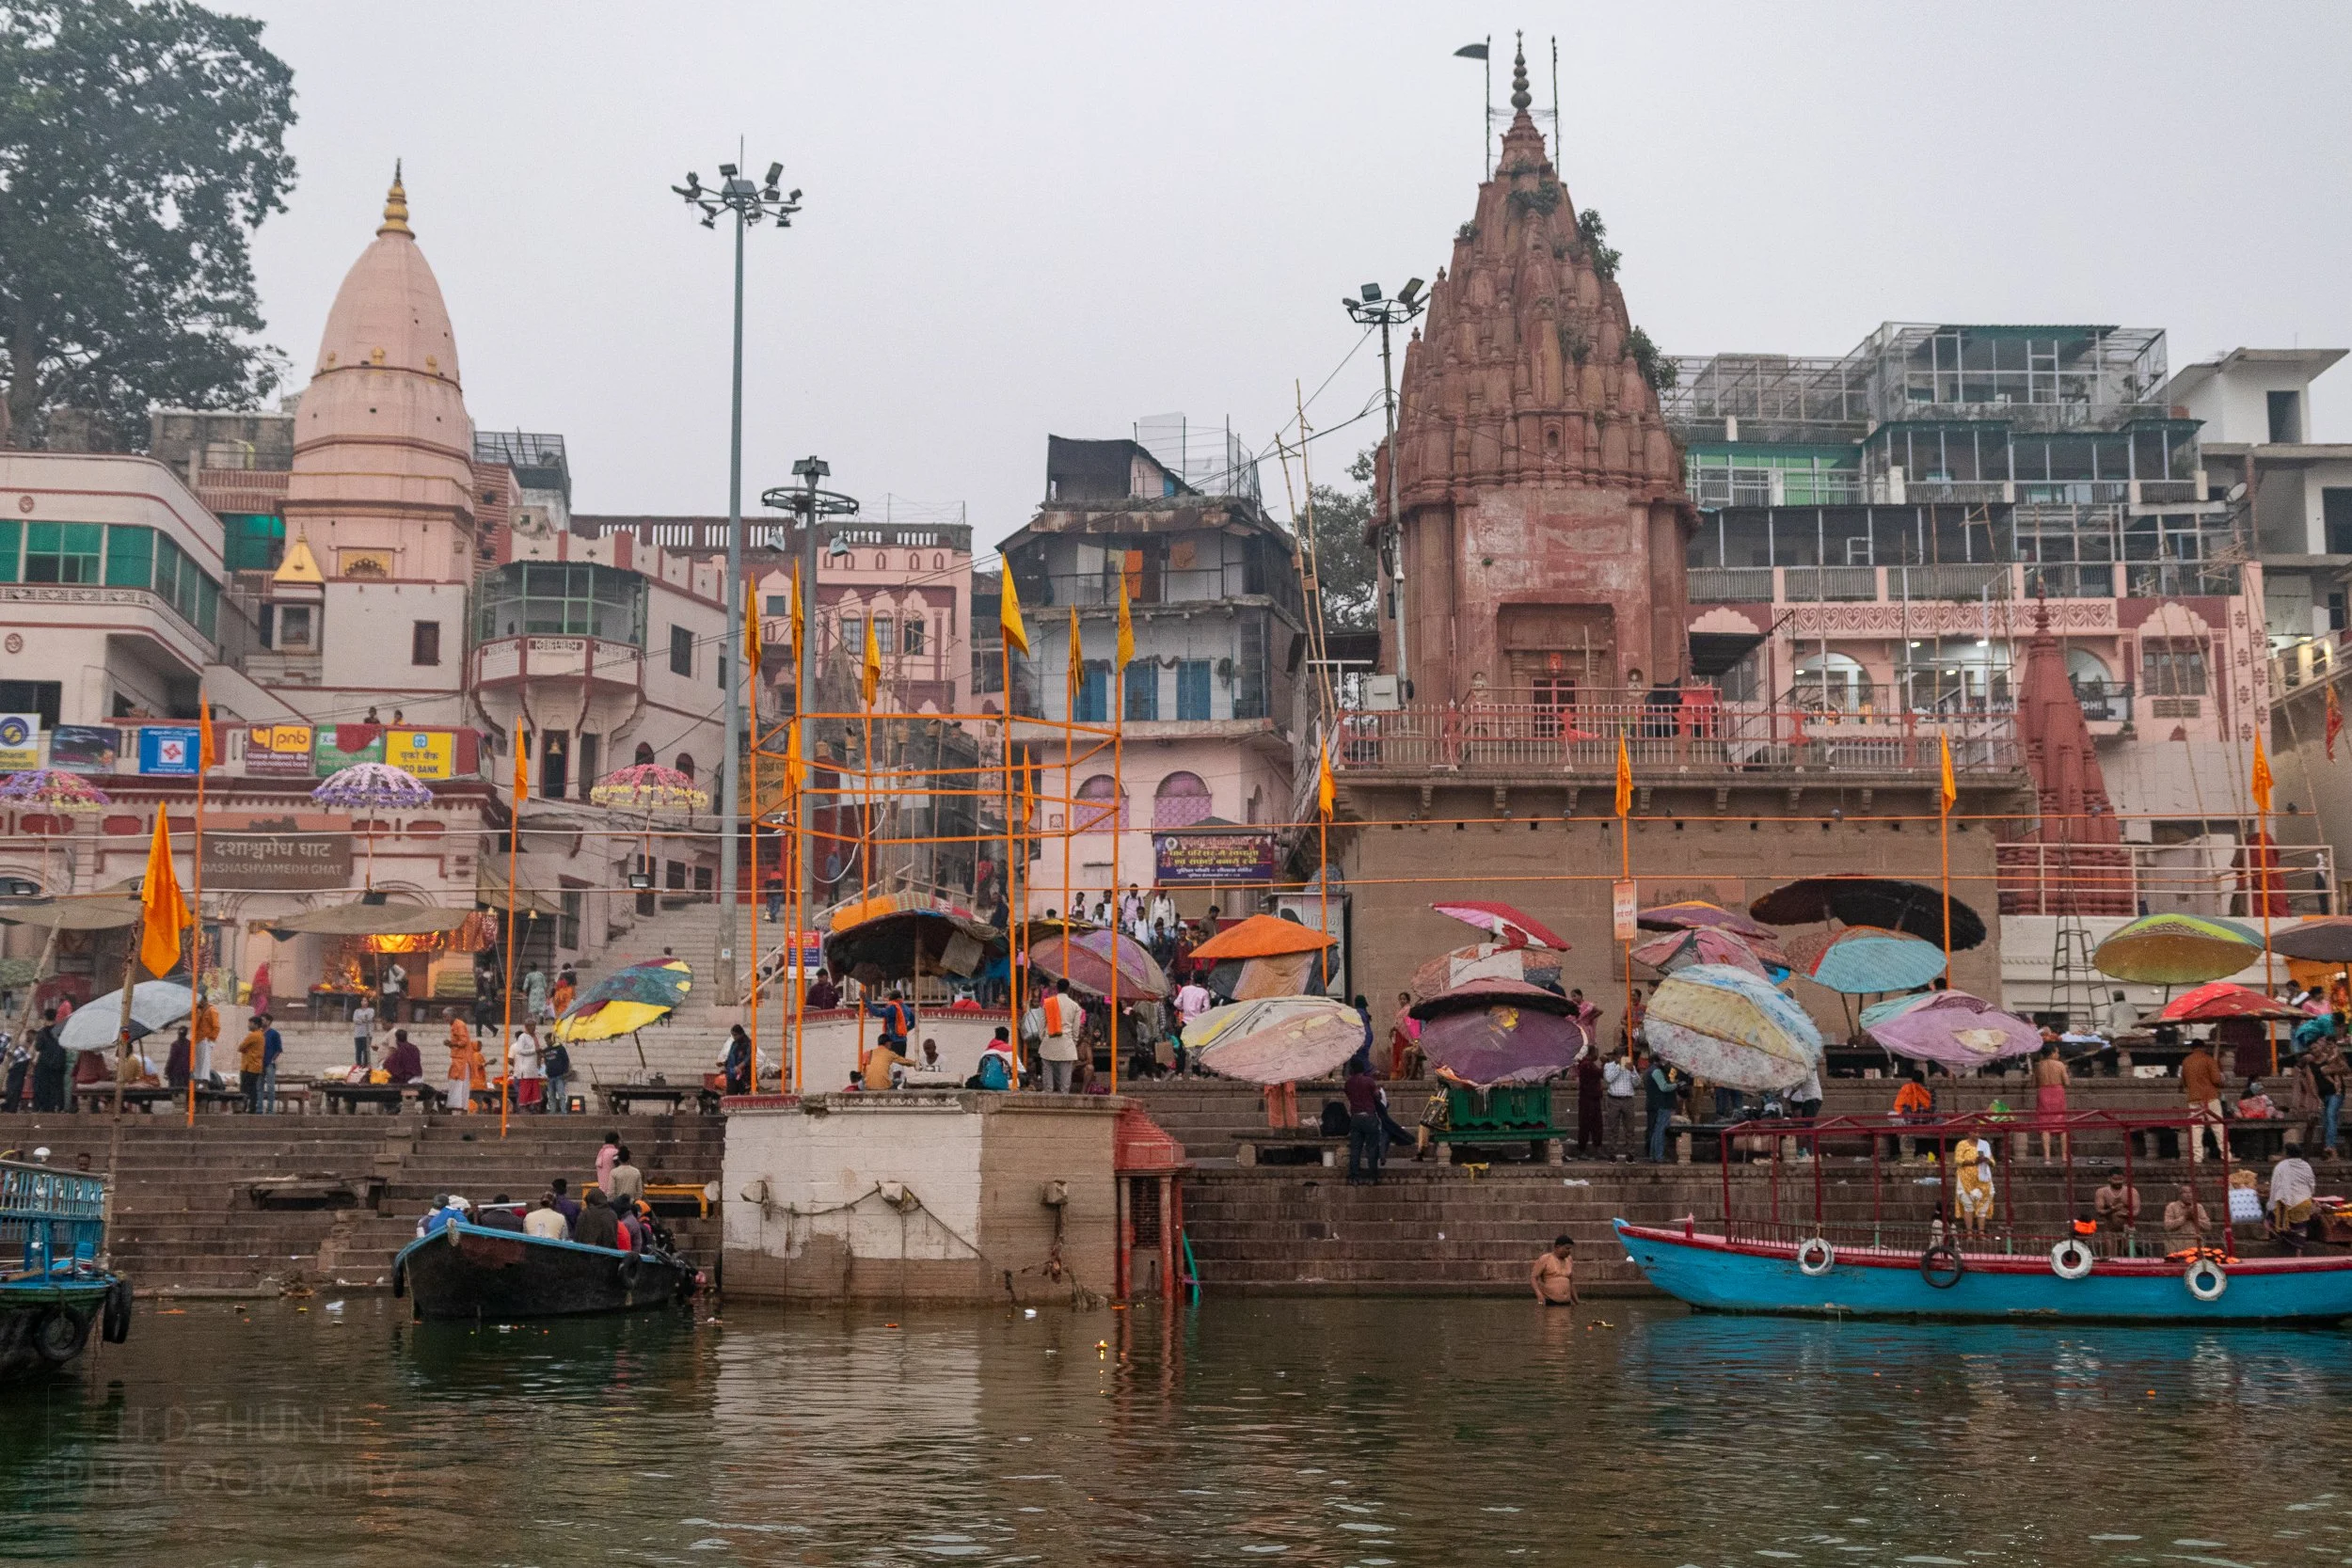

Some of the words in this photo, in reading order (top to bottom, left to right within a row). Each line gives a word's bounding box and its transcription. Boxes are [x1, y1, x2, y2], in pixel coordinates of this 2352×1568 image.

[276, 729, 307, 748] pnb
[214, 837, 294, 860] दशाश्वमेध
[299, 841, 332, 858] घाट
[201, 863, 310, 875] DASHASHVAMEDH
[310, 863, 342, 876] GHAT
